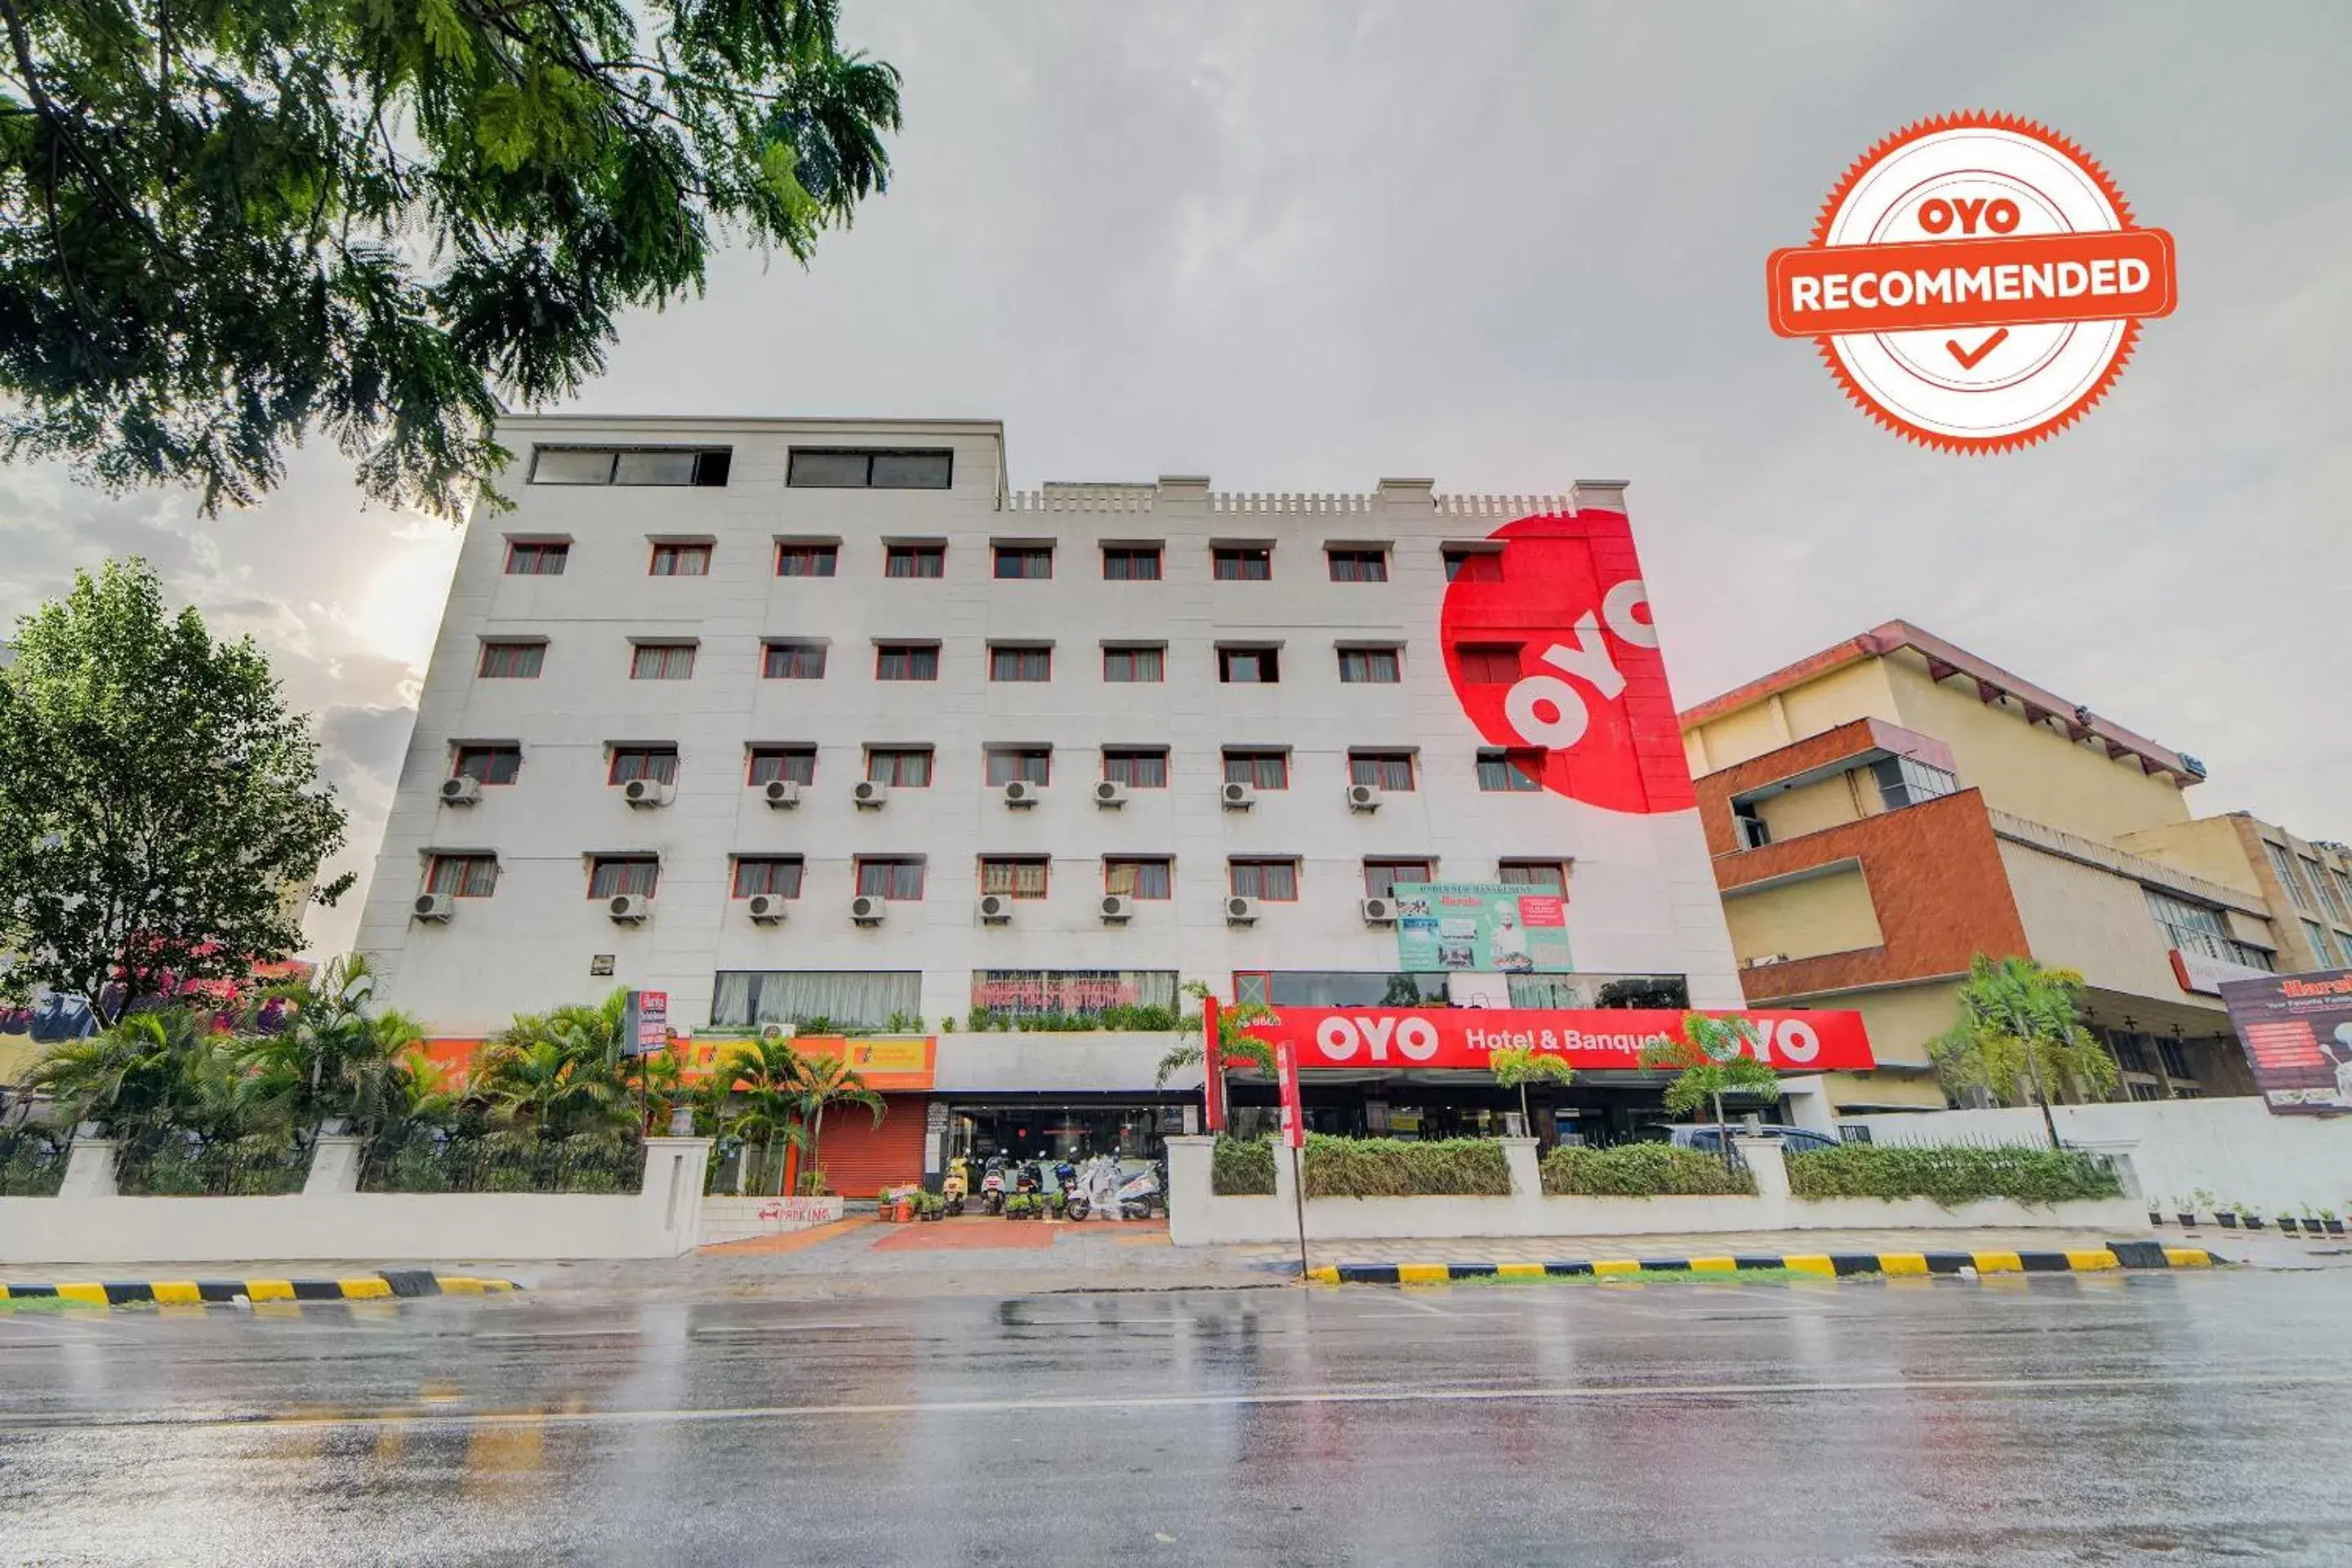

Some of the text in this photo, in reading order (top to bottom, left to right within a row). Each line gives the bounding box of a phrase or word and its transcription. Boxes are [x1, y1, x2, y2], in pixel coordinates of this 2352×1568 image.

[1504, 579, 1660, 751] OYO
[1316, 1016, 1439, 1061] OYO
[1465, 1028, 1671, 1054] Hotel & Banquet
